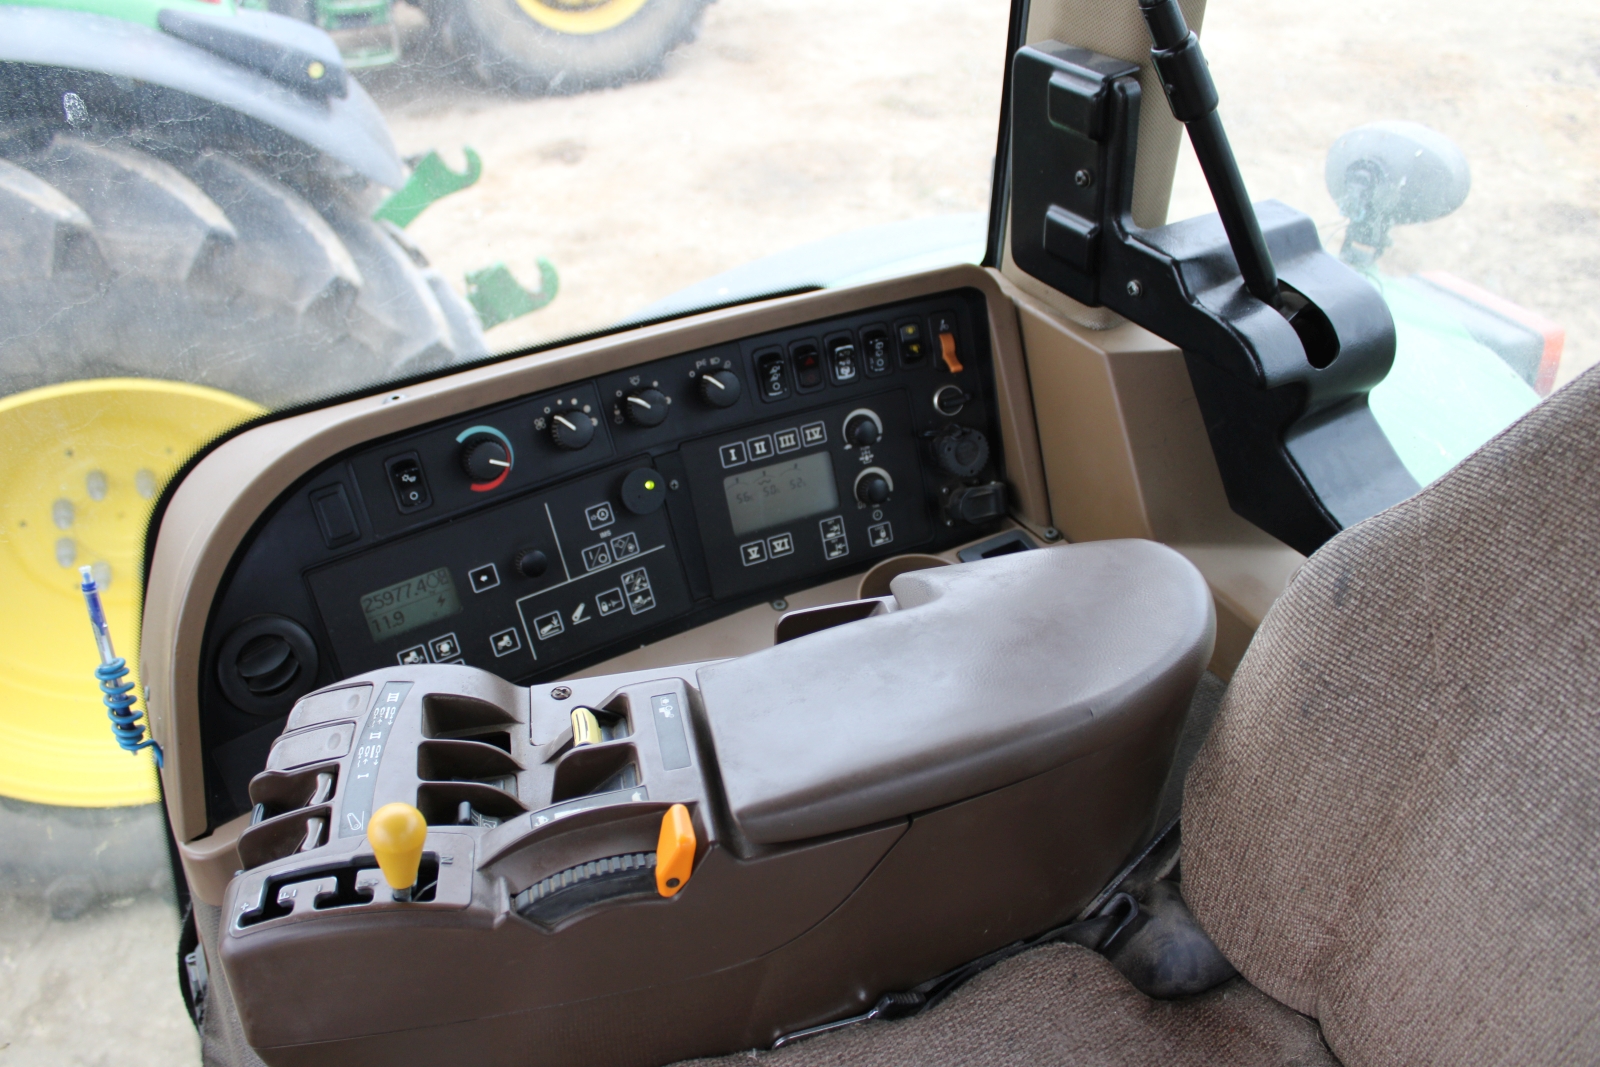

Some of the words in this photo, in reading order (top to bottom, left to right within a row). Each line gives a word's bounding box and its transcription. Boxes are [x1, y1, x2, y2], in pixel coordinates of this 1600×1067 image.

[779, 433, 796, 449] III
[804, 426, 823, 442] IV
[753, 441, 767, 455] II
[747, 546, 761, 560] V
[771, 538, 790, 553] VI
